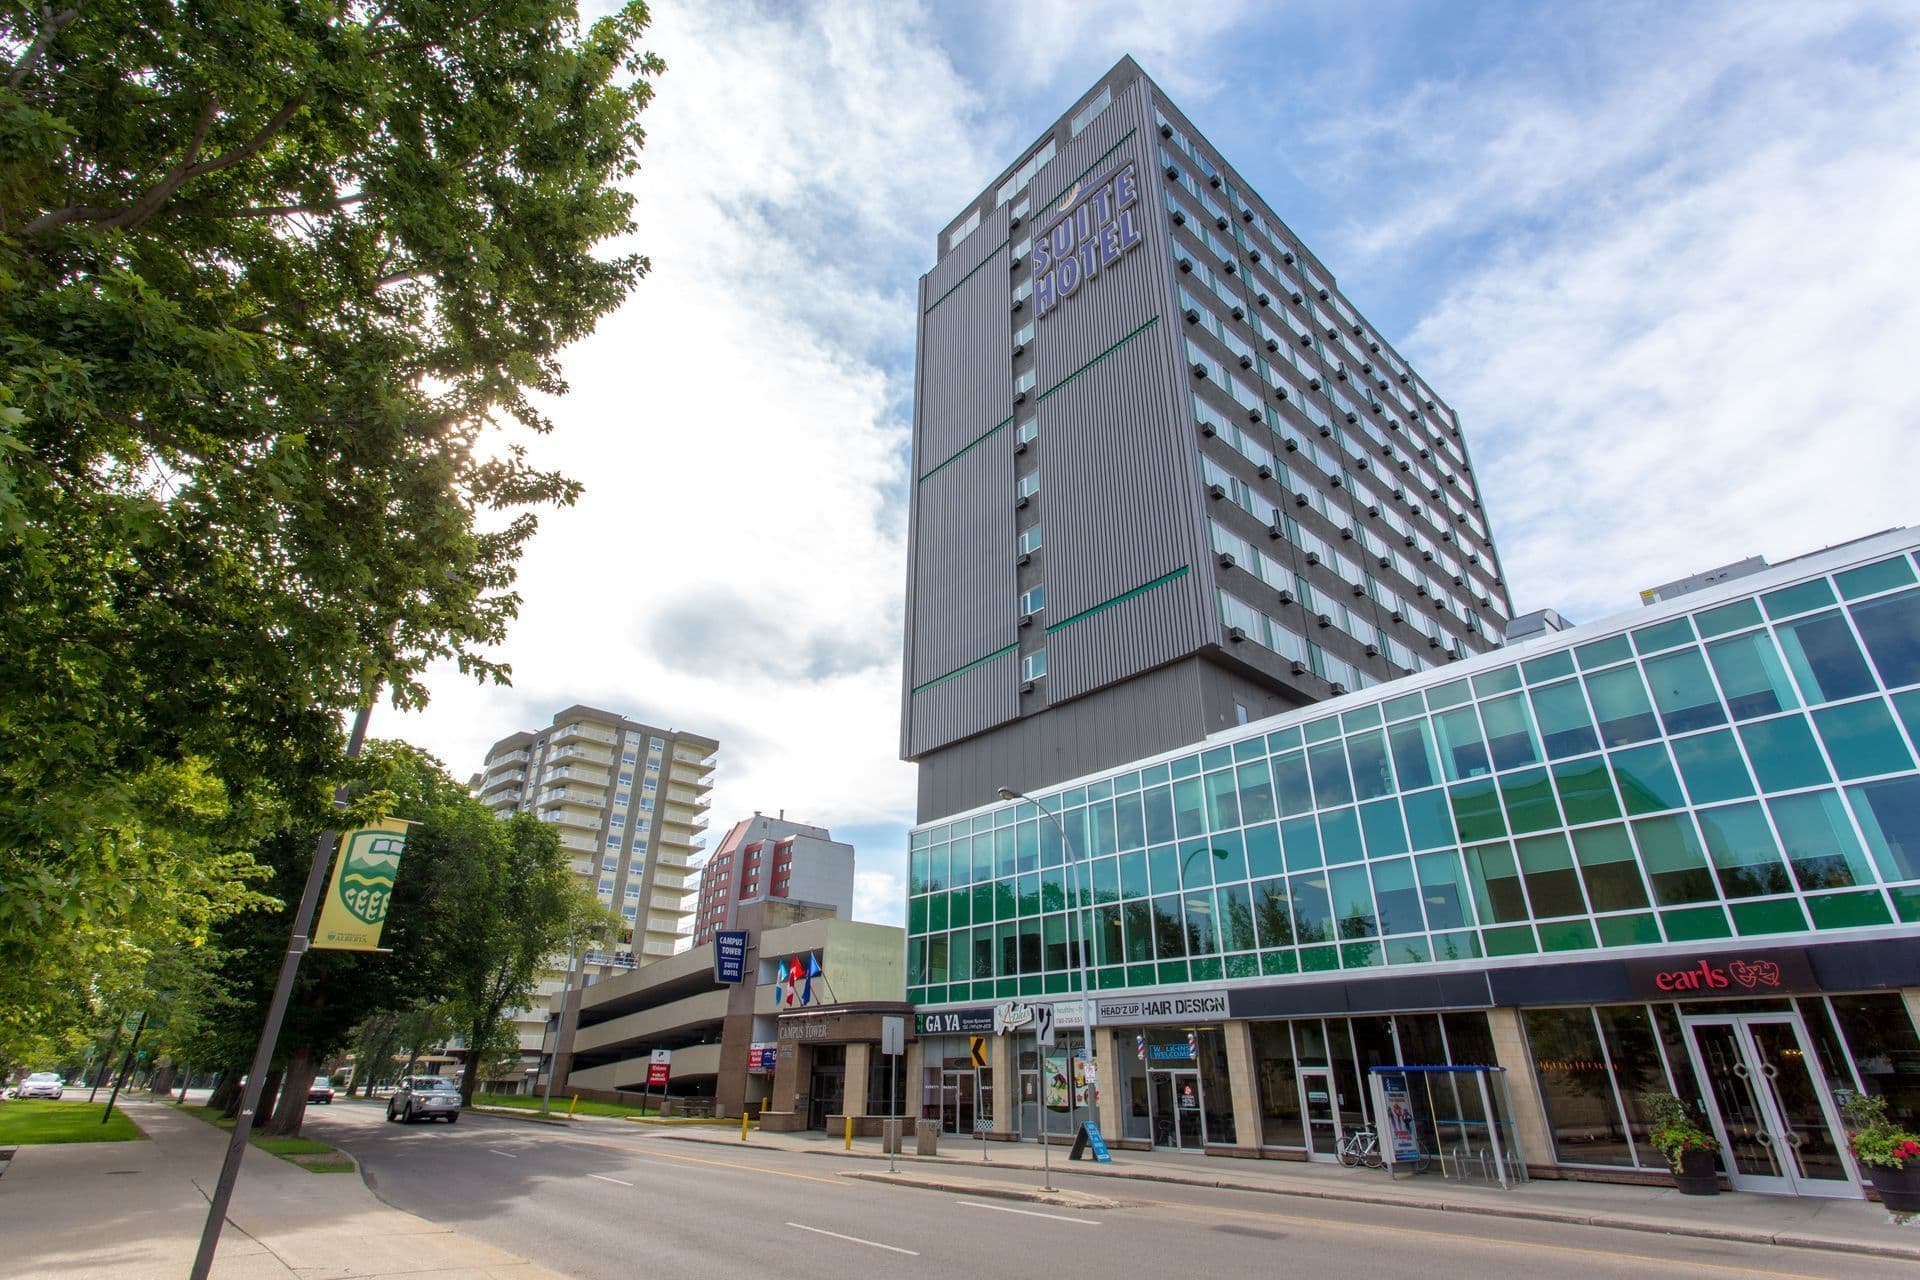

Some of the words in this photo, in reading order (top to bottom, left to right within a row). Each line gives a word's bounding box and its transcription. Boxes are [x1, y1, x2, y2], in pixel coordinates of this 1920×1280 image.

[1033, 164, 1138, 280] SUITE
[1034, 209, 1142, 319] HOTEL
[719, 936, 744, 946] CAMPUS
[721, 946, 742, 956] TOWER
[1656, 959, 1730, 991] earls
[1100, 1006, 1127, 1016] HEAD'Z
[1128, 1005, 1140, 1014] UP
[1141, 1001, 1173, 1016] HAIR
[1175, 997, 1226, 1015] DESIGN
[779, 1024, 804, 1039] CAMPUS
[805, 1024, 827, 1038] TOWER
[925, 1015, 942, 1032] GA
[944, 1014, 960, 1031] YA
